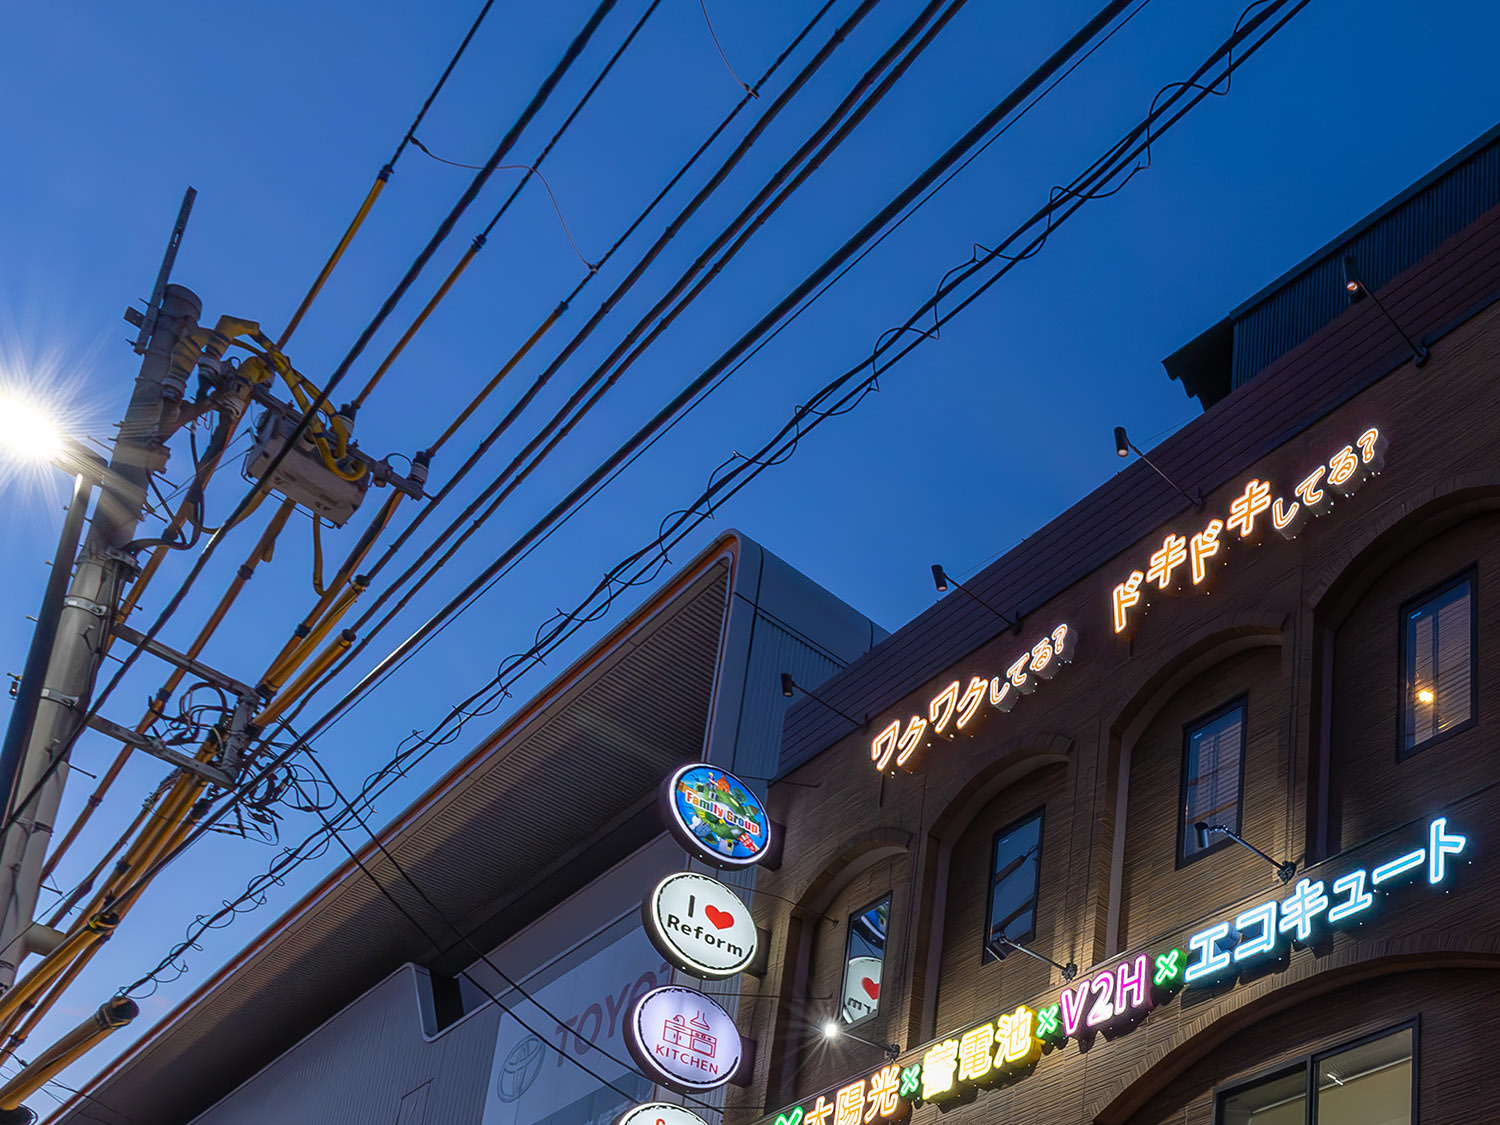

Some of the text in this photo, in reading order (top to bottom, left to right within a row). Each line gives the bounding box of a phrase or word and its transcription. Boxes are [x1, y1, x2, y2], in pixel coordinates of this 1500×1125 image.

[1112, 427, 1380, 634] ドキドキしてる?
[871, 622, 1069, 772] ワクワクしてる?
[685, 790, 759, 834] Family Group
[666, 913, 744, 959] Reform
[555, 963, 672, 1068] TOYO
[654, 1043, 720, 1076] KITCHEN
